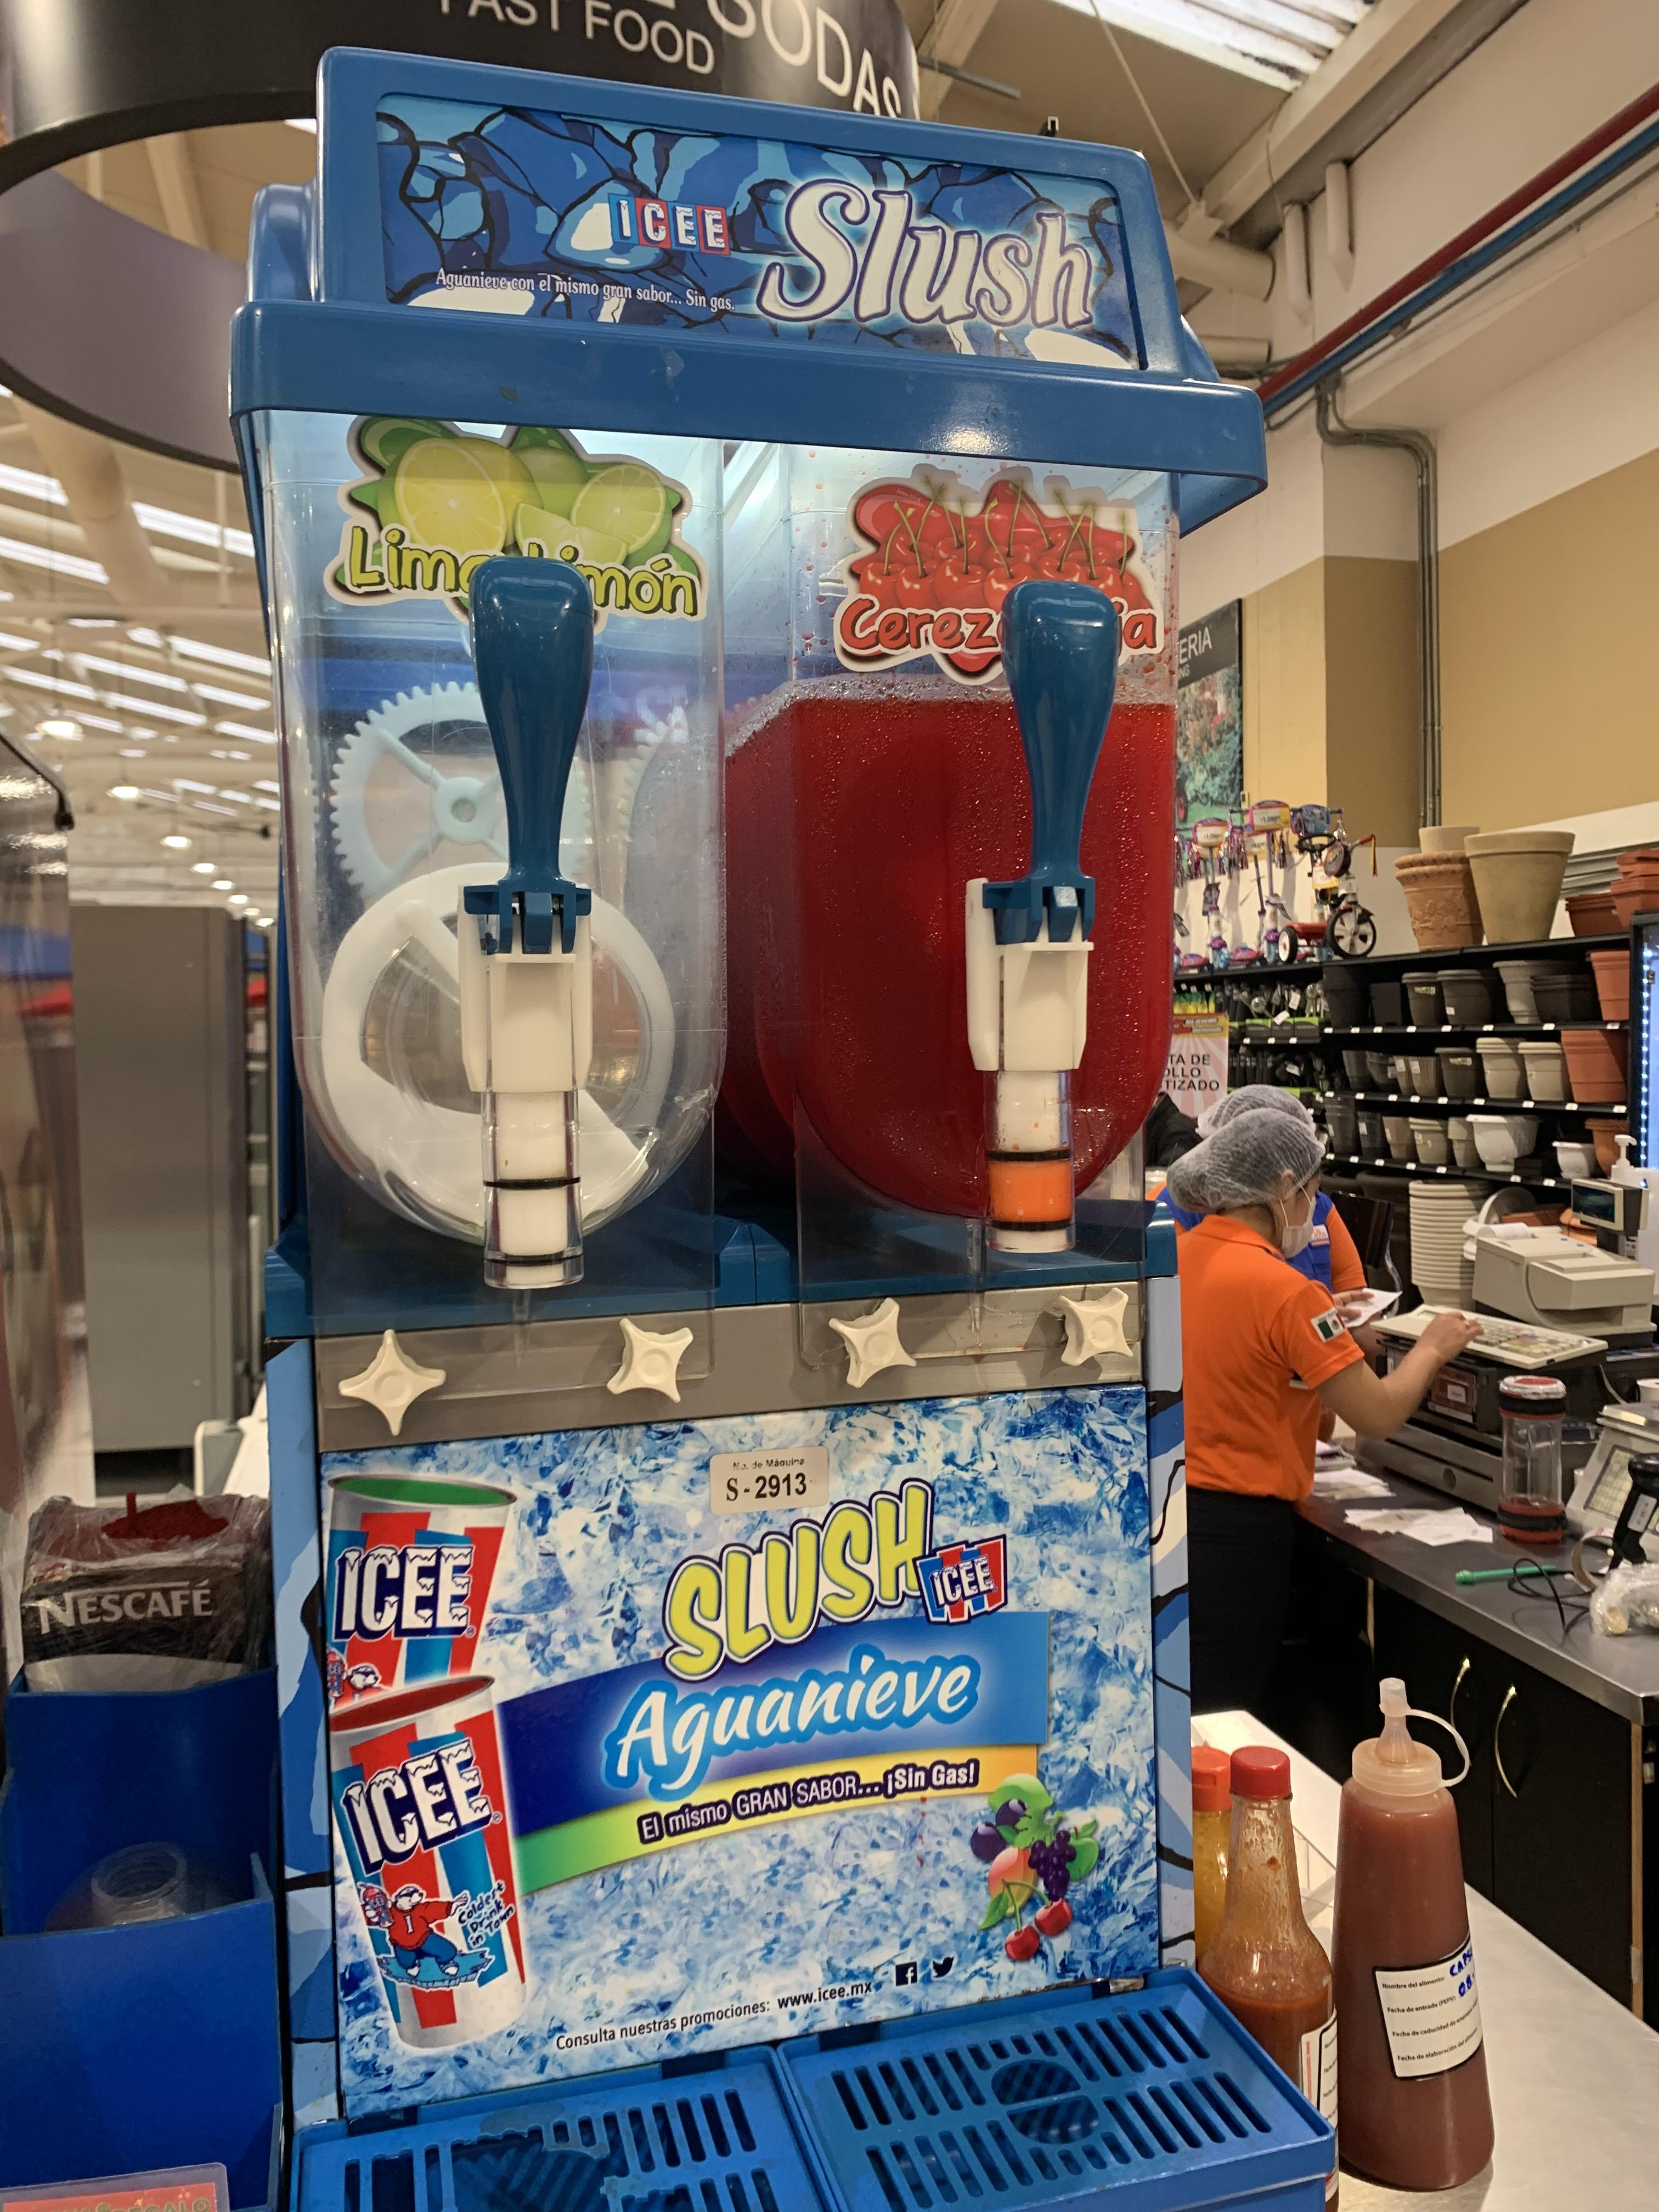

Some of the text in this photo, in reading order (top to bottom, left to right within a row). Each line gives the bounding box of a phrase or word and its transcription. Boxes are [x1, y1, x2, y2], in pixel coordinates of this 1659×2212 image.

[585, 1, 714, 74] FOOD
[614, 197, 727, 251] ICEE
[756, 178, 1093, 328] Slush
[436, 267, 735, 312] Aguanieve con el mismo gran sabor... Sin gas.
[839, 598, 1003, 650] Cerez
[1160, 1079, 1220, 1091] TIZADO
[1191, 1053, 1210, 1065] DE
[38, 1579, 214, 1634] NESCAFÉ
[332, 1545, 475, 1640] ICEE
[662, 1480, 933, 1680] SLUSH
[929, 1555, 995, 1607] ICEE
[614, 1655, 972, 1791] Aguanieve
[341, 1738, 493, 1876] ICEE
[641, 1762, 975, 1841] El mismo GRAN SABOR... ¡Sin Gas!
[470, 1899, 503, 1933] Drink
[470, 1906, 514, 1946] in Town
[556, 1981, 873, 2050] Consulta nuestras promociones: www.icee.mx
[1415, 2003, 1438, 2012] entrada
[1420, 2023, 1449, 2035] caducidad
